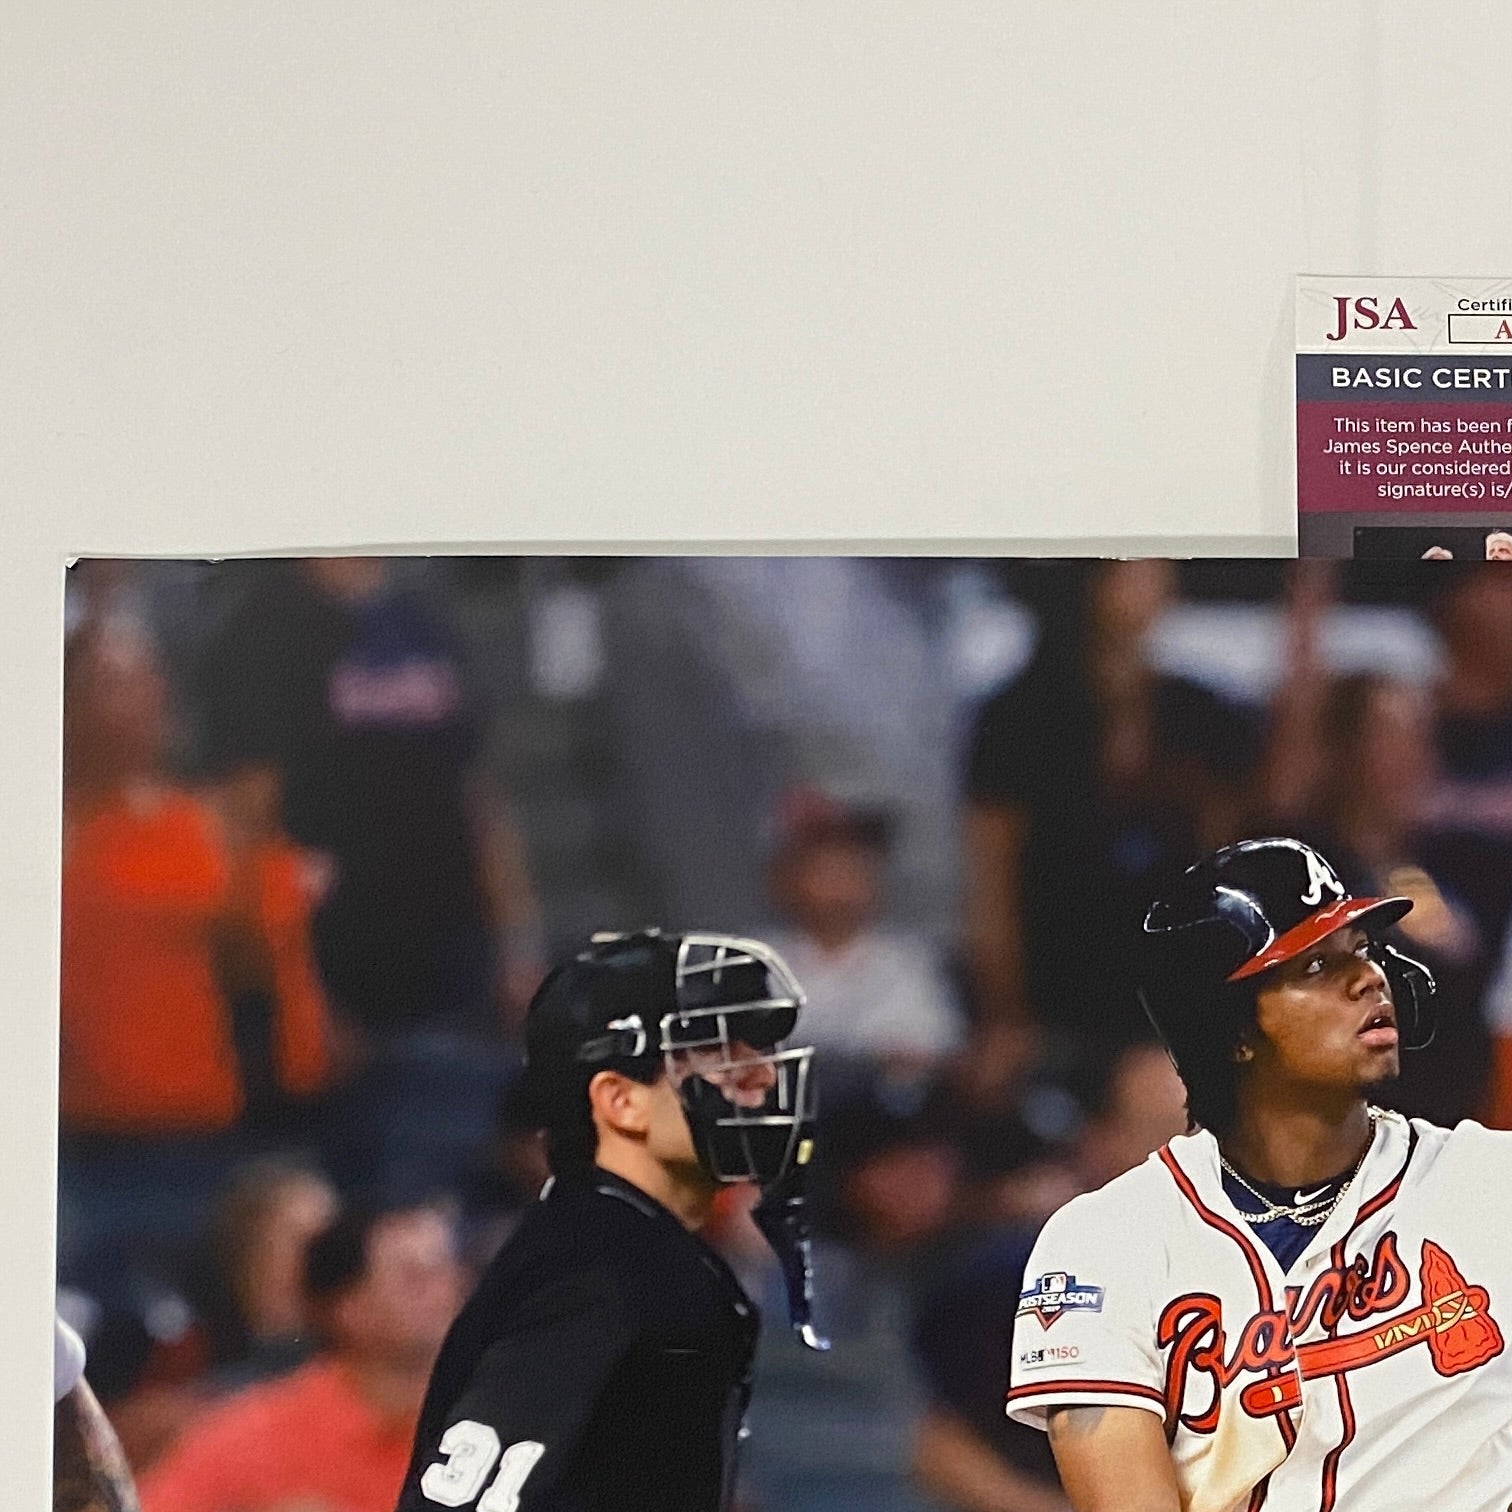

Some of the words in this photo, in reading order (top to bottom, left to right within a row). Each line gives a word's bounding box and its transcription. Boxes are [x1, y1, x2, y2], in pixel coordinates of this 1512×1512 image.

[1326, 296, 1418, 341] JSA
[1332, 367, 1423, 389] BASIC
[1333, 418, 1370, 433] This
[1375, 418, 1415, 433] item
[1420, 418, 1451, 433] has
[1457, 418, 1501, 433] been
[1323, 439, 1381, 454] James
[1386, 439, 1453, 456] Spence
[1339, 460, 1351, 475] it
[1357, 460, 1371, 475] is
[1376, 463, 1407, 475] our
[1411, 460, 1511, 475] considered
[1377, 481, 1485, 499] signature(s)
[1300, 849, 1353, 906] A
[1157, 1230, 1411, 1444] Baves
